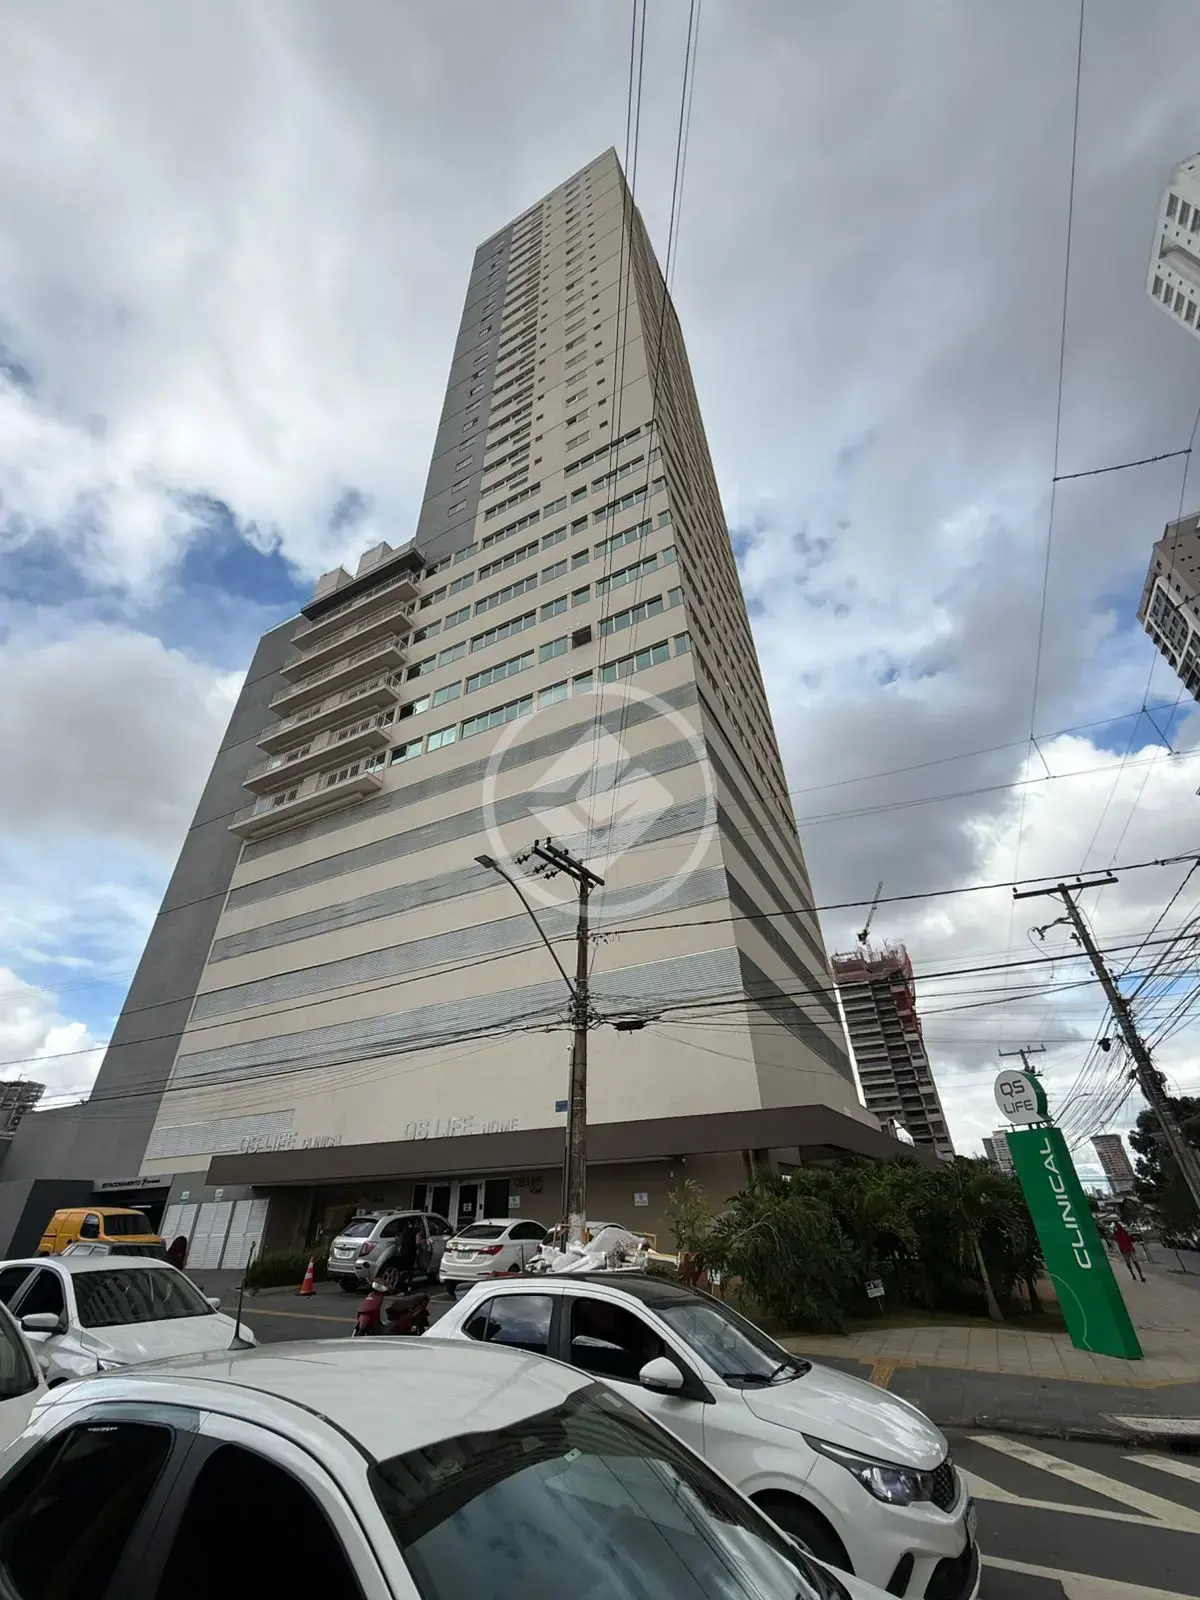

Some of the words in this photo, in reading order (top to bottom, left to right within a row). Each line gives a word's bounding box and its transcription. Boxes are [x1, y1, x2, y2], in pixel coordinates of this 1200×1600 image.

[1000, 1079, 1025, 1098] QS
[1003, 1099, 1034, 1114] LIFE
[434, 1114, 475, 1138] LIFE
[1039, 1136, 1092, 1269] CLINICAL
